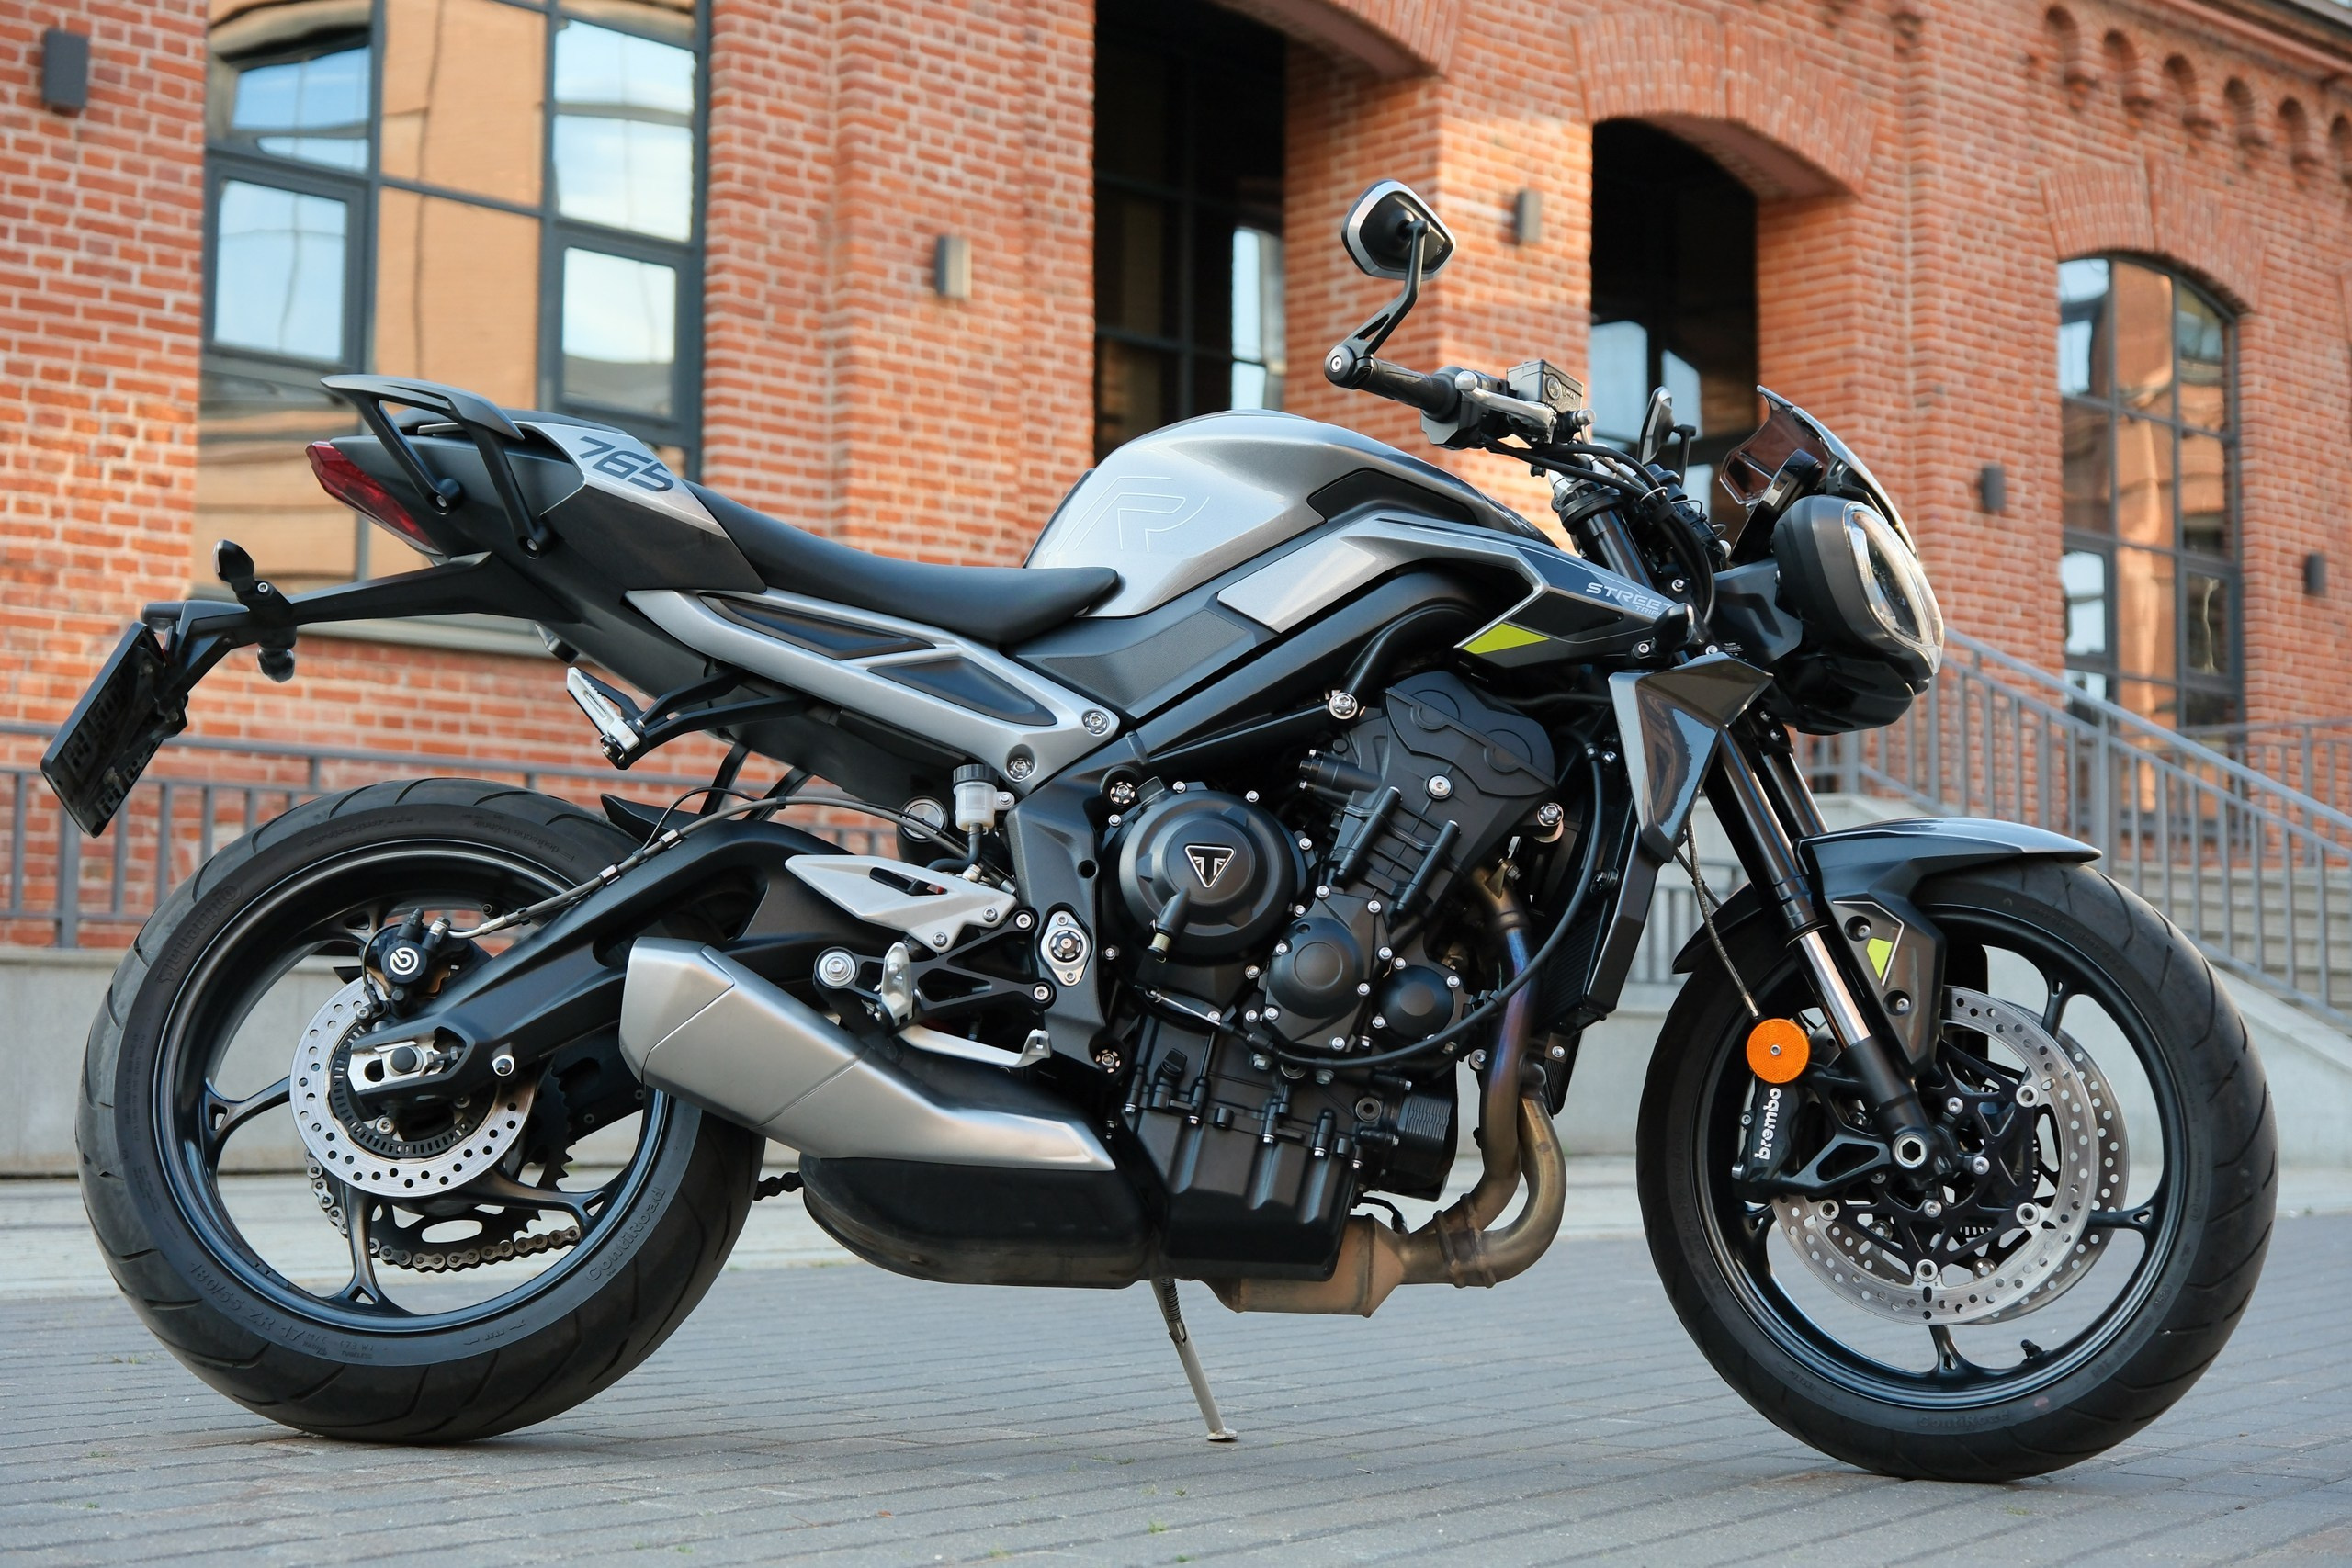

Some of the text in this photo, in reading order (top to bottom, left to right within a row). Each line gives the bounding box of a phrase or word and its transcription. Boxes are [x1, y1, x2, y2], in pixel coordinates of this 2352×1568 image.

[579, 435, 674, 492] 765
[1754, 1087, 1781, 1160] brembo
[586, 1186, 666, 1281] ContiRoad
[187, 1260, 245, 1311] 180/55
[243, 1305, 277, 1331] ZR
[277, 1322, 305, 1343] 17
[1917, 1407, 2010, 1428] ContiRoad
